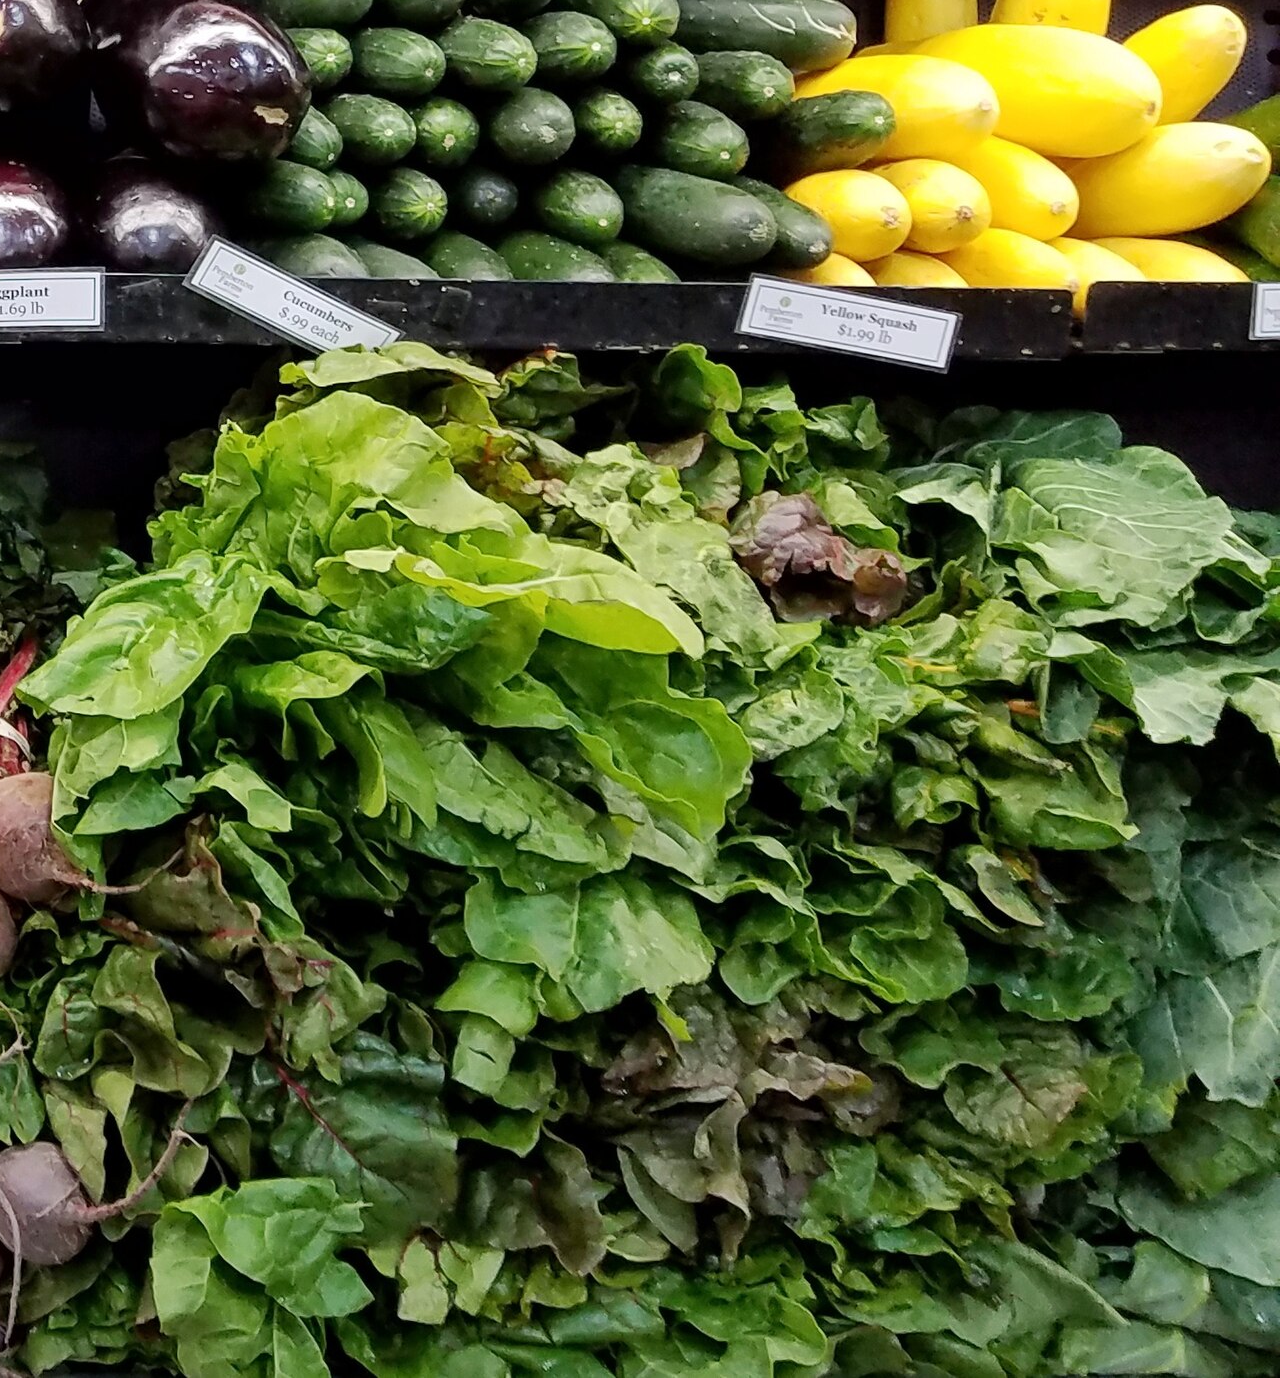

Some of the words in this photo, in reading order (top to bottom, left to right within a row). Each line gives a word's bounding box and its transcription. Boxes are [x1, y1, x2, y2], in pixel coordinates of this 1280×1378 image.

[31, 302, 44, 315] lb
[283, 290, 354, 333] Cucumbers
[821, 303, 867, 322] Yellow
[868, 312, 918, 332] Squash
[278, 306, 309, 331] $.99
[310, 322, 340, 344] each
[837, 323, 876, 344] $1.99
[878, 329, 893, 345] lb
